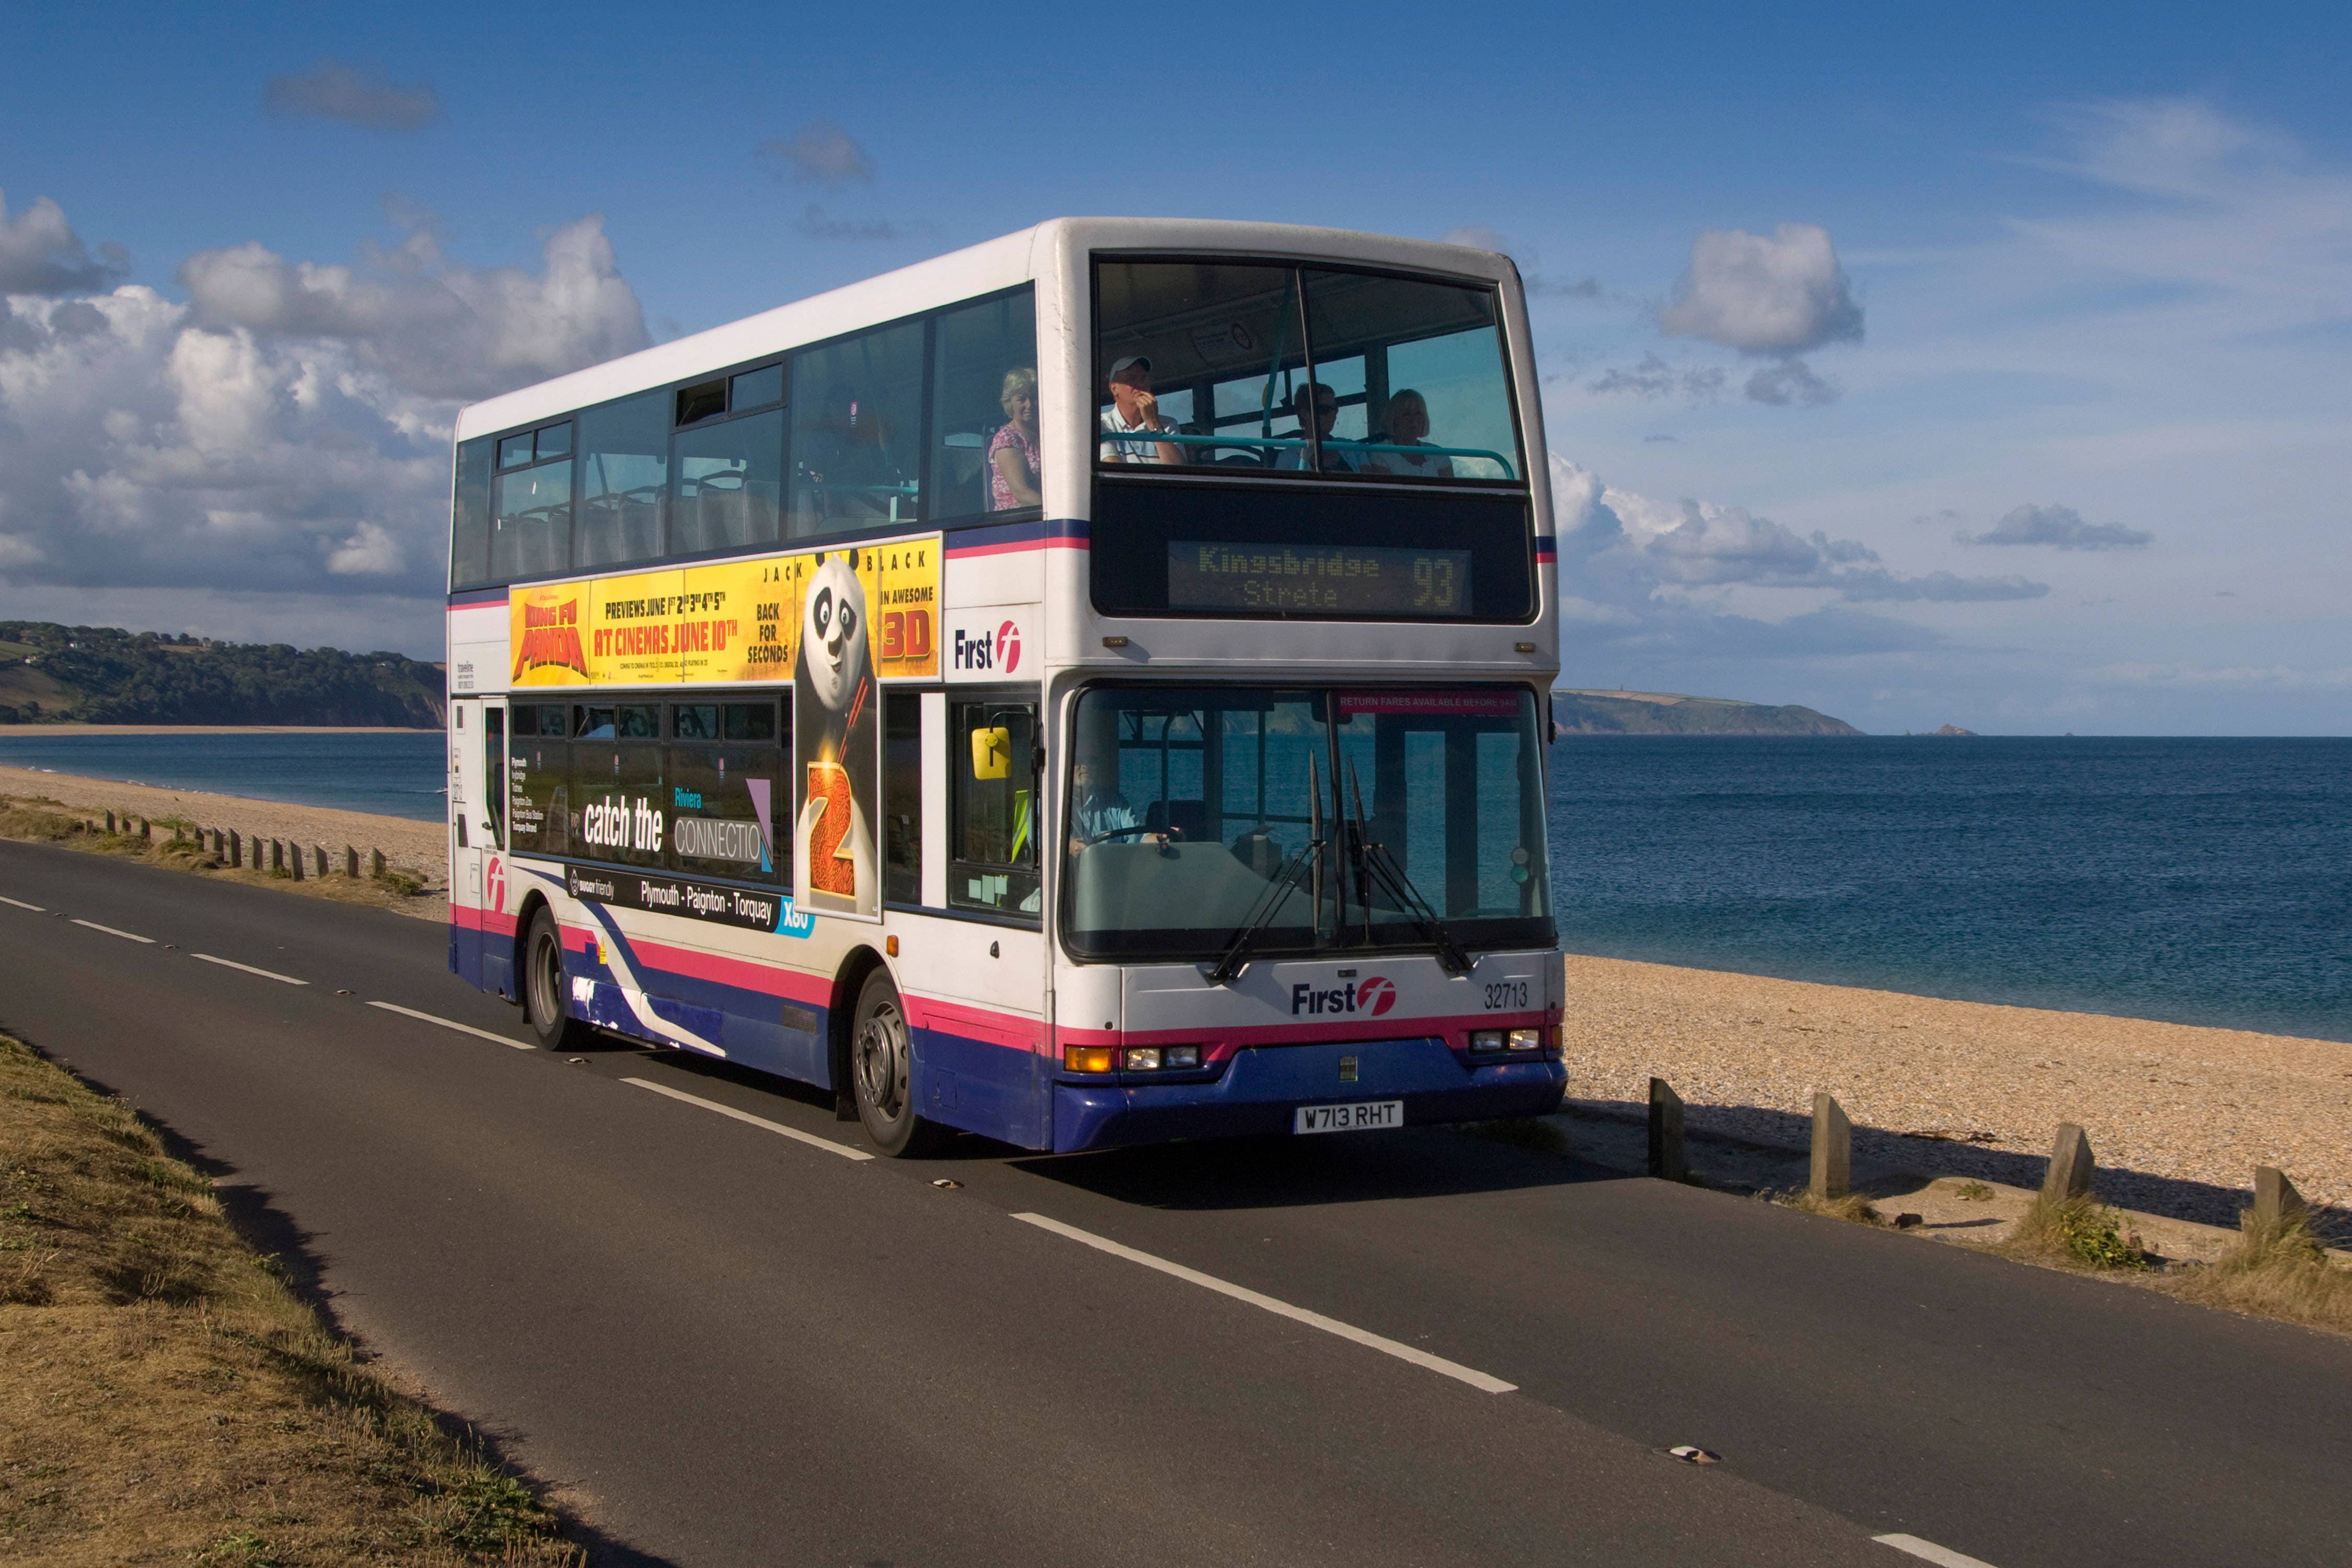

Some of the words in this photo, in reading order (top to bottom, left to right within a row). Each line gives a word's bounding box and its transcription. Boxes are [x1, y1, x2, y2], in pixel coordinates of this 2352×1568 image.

[764, 562, 802, 583] JACK
[867, 550, 925, 572] BLACK
[1198, 546, 1380, 578] Kingsbridge
[1413, 557, 1453, 607] 93
[605, 599, 645, 620] PREVIEWS
[646, 597, 665, 616] JUNE
[701, 592, 713, 611] 4TH
[714, 591, 726, 610] 5TH
[880, 591, 889, 605] IN
[892, 586, 933, 604] AWESOME
[1244, 580, 1338, 607] Strete
[525, 603, 557, 628] KUNG
[559, 597, 577, 625] FU
[757, 603, 780, 621] BACK
[594, 628, 613, 656] AT
[615, 625, 668, 656] CINEMAS
[672, 621, 709, 653] JUNE
[712, 619, 738, 651] 10TH
[759, 624, 777, 642] FOR
[882, 608, 931, 661] 3D
[512, 627, 589, 683] PANDA
[747, 644, 788, 664] SECONDS
[955, 629, 992, 670] First
[1340, 697, 1378, 706] RETURN
[1381, 697, 1410, 706] FARES
[1413, 697, 1461, 707] AVAILABLE
[1463, 698, 1498, 707] BEFORE
[674, 787, 701, 809] Riviera
[584, 794, 630, 847] catch
[635, 797, 663, 852] the
[595, 879, 614, 901] friendly
[641, 881, 679, 908] Plymouth
[687, 886, 725, 915] Paignton
[733, 892, 772, 926] Torquay
[1292, 983, 1355, 1015] First
[1484, 982, 1528, 1009] 32713
[1305, 1108, 1350, 1129] W713
[1355, 1104, 1396, 1125] RHT
